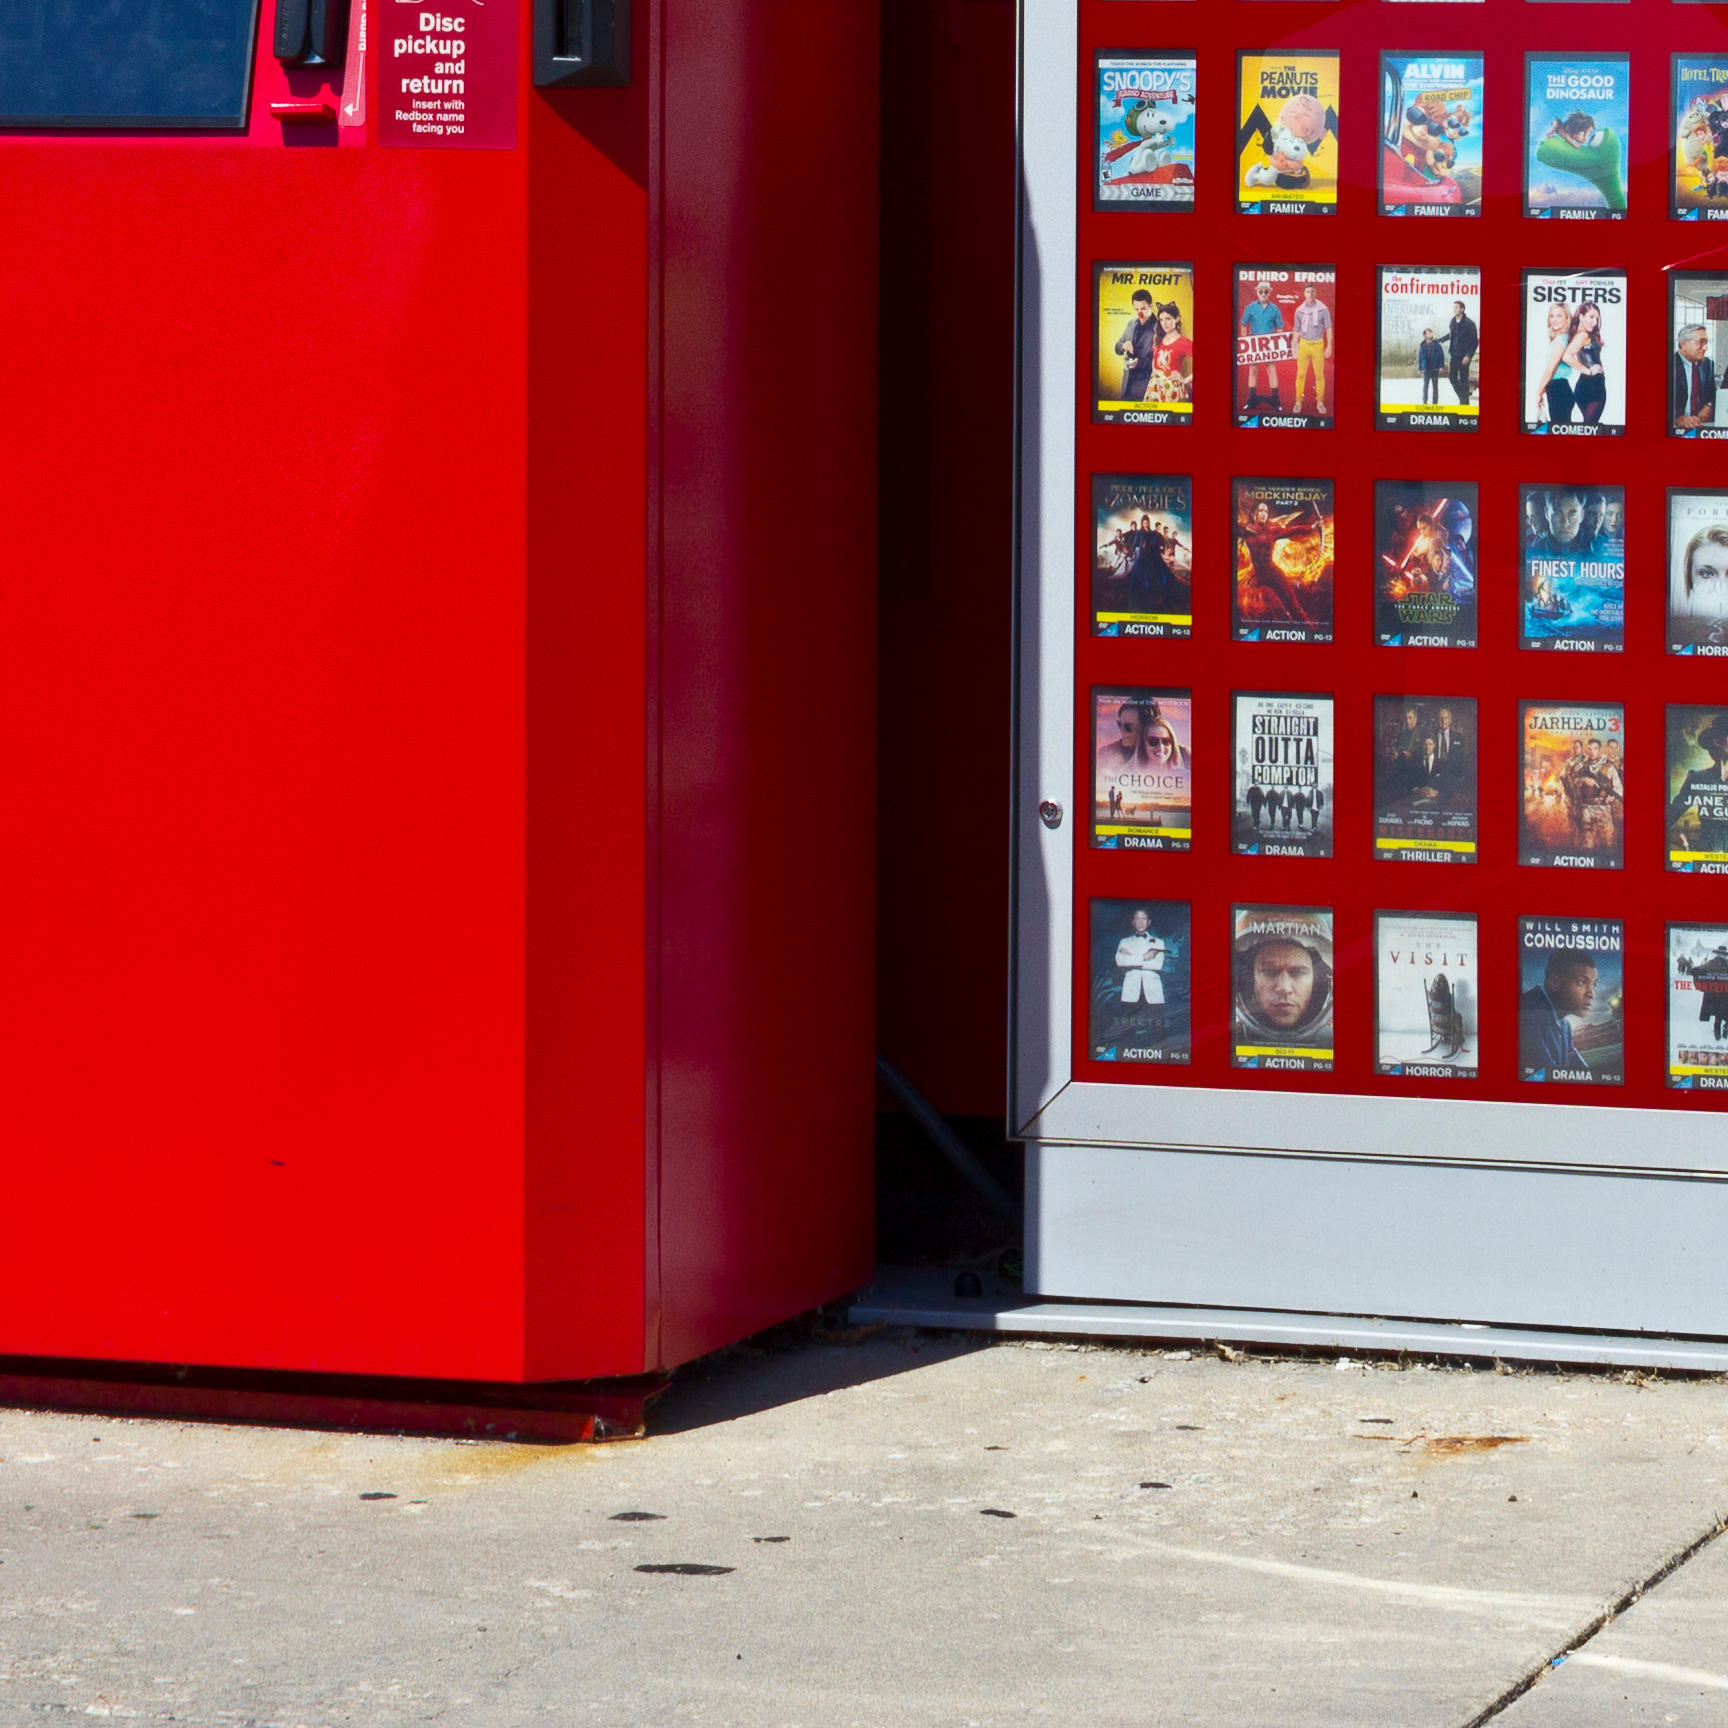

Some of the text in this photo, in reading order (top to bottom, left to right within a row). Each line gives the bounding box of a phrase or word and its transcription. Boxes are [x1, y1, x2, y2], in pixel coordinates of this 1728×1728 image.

[420, 13, 465, 31] Disc
[394, 36, 465, 57] pickup
[435, 60, 465, 74] and
[1405, 64, 1464, 78] ALVIN
[402, 75, 464, 93] return
[1104, 71, 1191, 91] SNOOPY'S
[1261, 71, 1317, 85] PEANUTS
[1548, 74, 1614, 87] THE GOOD
[1261, 85, 1317, 99] MOVIE
[1425, 90, 1469, 102] ROAD CHIP
[1546, 88, 1614, 100] DINOSAUR
[412, 99, 464, 109] insert with
[396, 110, 464, 121] Redbox name
[412, 123, 464, 134] facing you
[1270, 203, 1305, 213] FAMILY
[1139, 274, 1181, 286] RIGHT
[1295, 271, 1335, 282] EFRON
[1385, 280, 1478, 296] confirmation
[1533, 286, 1621, 303] SISTERS
[1237, 335, 1294, 352] DIRTY
[1237, 350, 1294, 364] GRANDPA
[1263, 417, 1307, 428] COMEDY
[1245, 490, 1327, 501] MOCKINGJAY
[1531, 560, 1624, 579] FINEST HOURS
[1404, 592, 1452, 605] STAR
[1400, 609, 1455, 624] WARS
[1408, 636, 1448, 646] ACTION
[1254, 716, 1316, 735] STRAIGHT
[1529, 716, 1620, 732] JARHEAD 3
[1254, 737, 1315, 765] OUTTA
[1118, 774, 1183, 789] CHOICE
[1254, 766, 1316, 784] COMPTON
[1684, 796, 1723, 807] JANE
[1699, 807, 1709, 816] A
[1401, 851, 1451, 862] THRILLER
[1252, 922, 1320, 936] MARTIAN
[1525, 922, 1619, 934] WILL SMITH
[1524, 934, 1620, 951] CONCUSSION
[1390, 951, 1467, 966] VISIT
[1674, 981, 1692, 990] THE
[1406, 1066, 1451, 1077] HORROR
